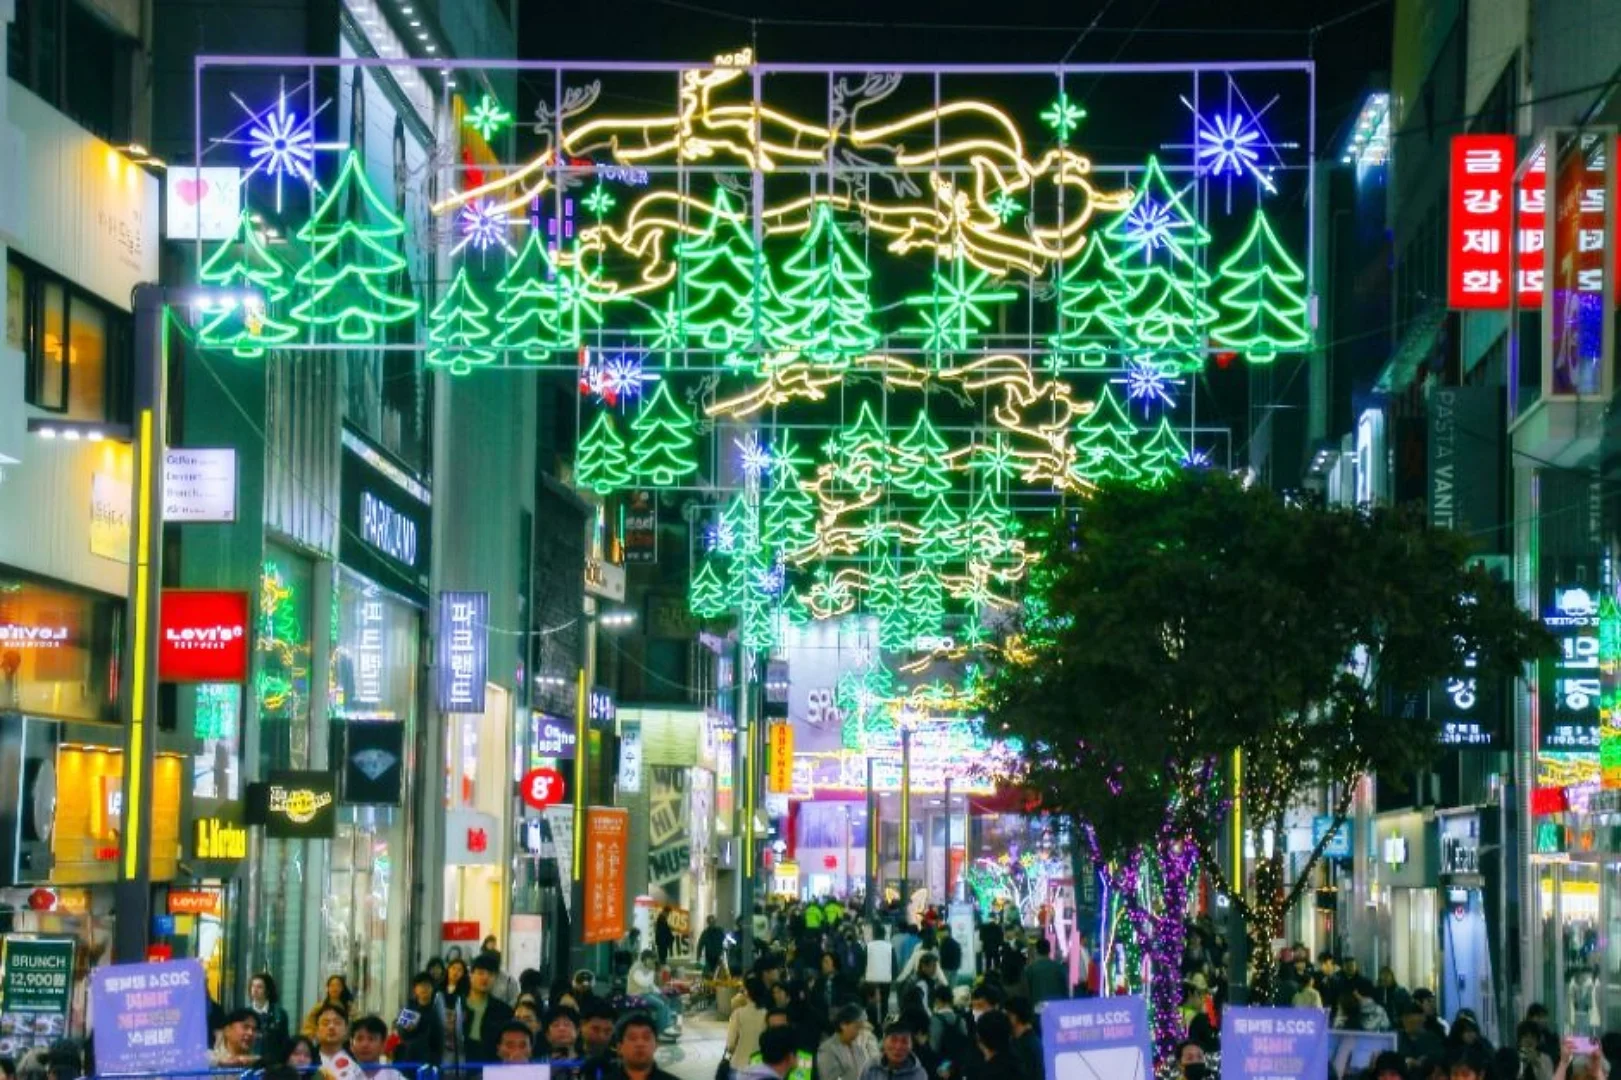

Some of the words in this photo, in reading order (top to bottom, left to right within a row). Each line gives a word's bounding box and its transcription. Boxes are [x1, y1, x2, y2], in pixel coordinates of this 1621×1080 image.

[1462, 149, 1502, 294] 금강제화
[1434, 390, 1455, 458] PASTA
[361, 491, 417, 567] PARKLAND
[450, 600, 477, 703] 파크랜드
[11, 954, 66, 968] BRUNCH
